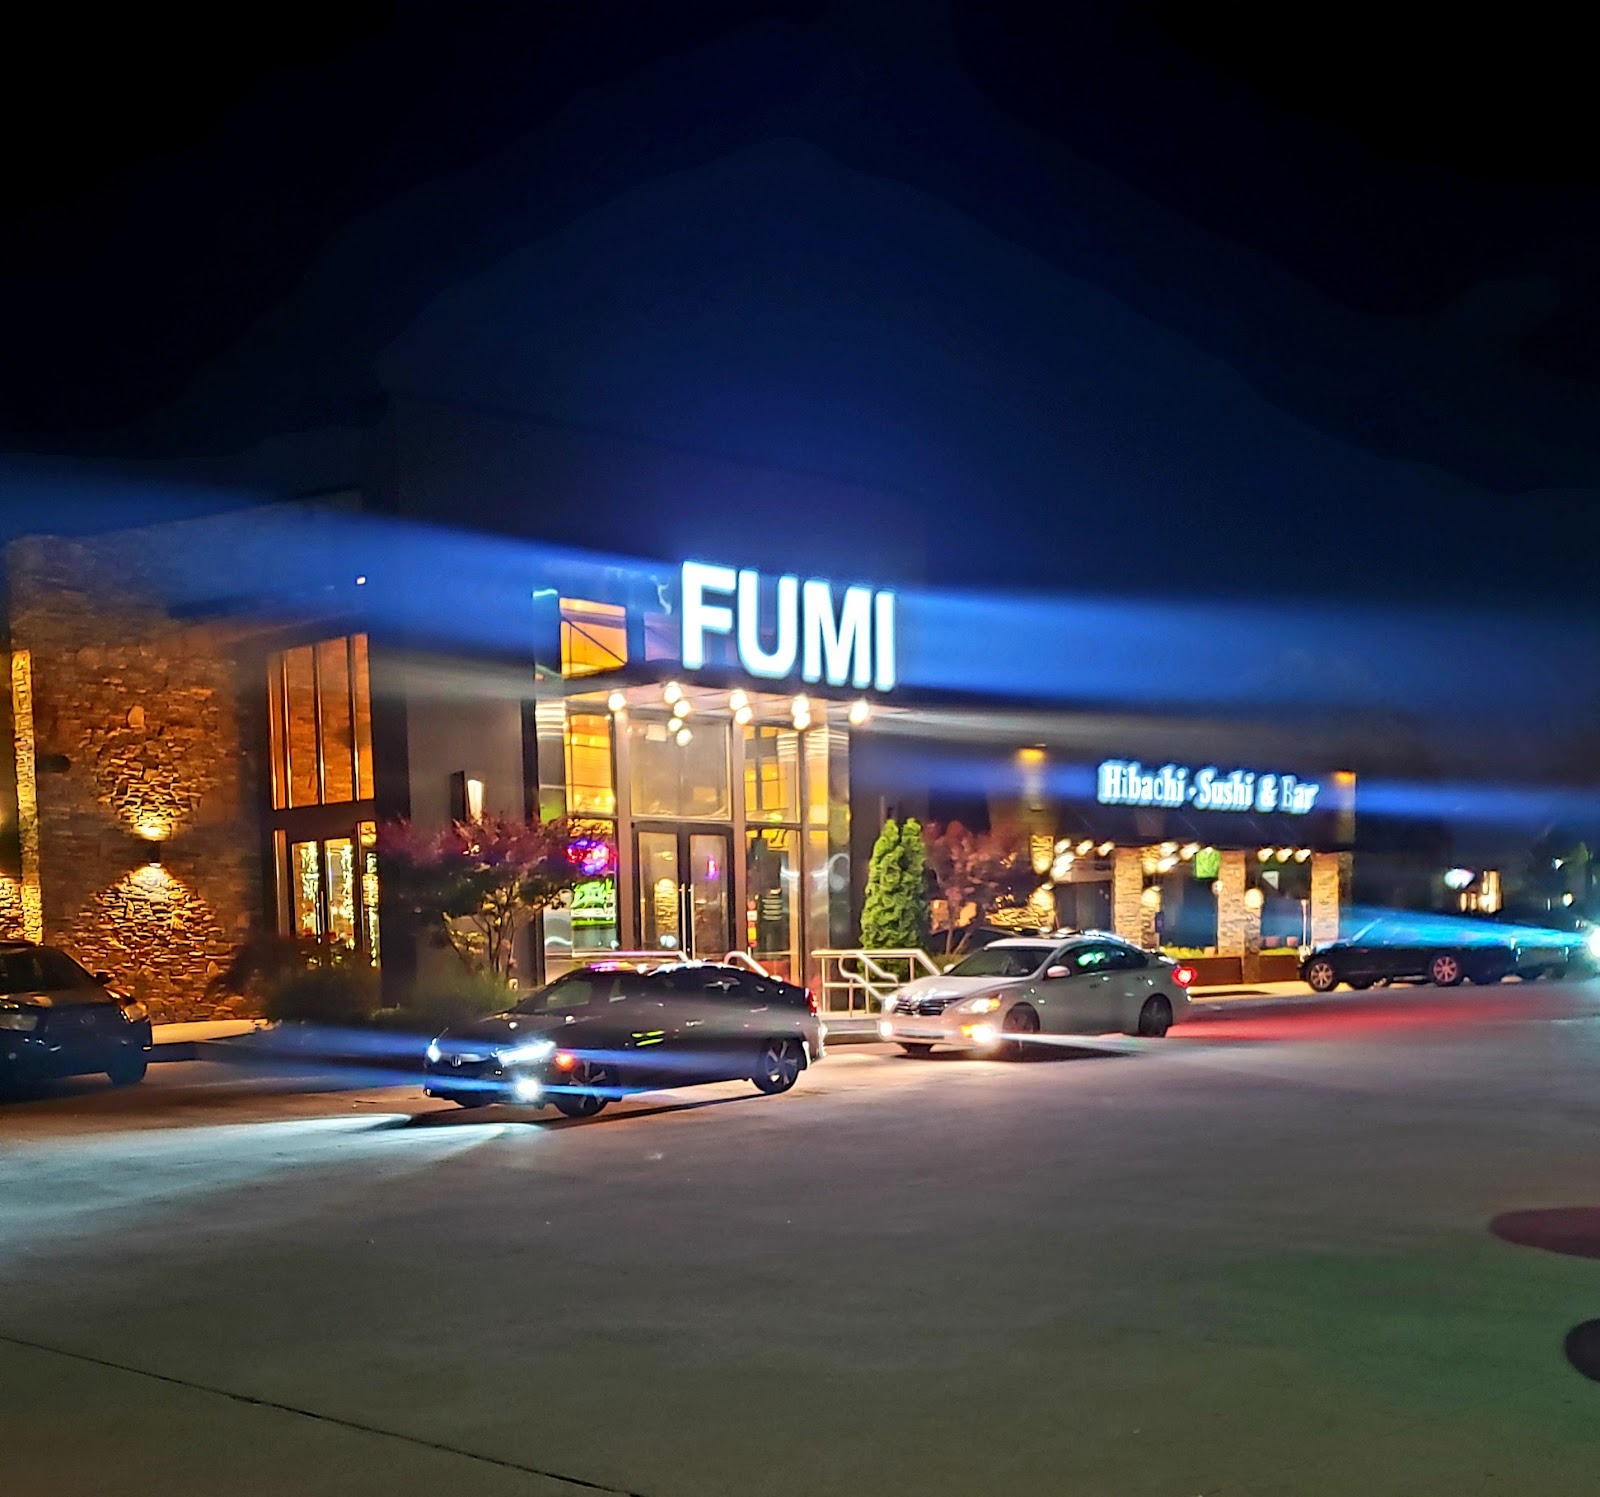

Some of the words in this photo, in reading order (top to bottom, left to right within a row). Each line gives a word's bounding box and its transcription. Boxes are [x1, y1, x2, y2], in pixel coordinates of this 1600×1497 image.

[681, 560, 896, 692] FUMI
[1098, 760, 1187, 807] Hibachi
[1195, 767, 1254, 811] Sushi
[1255, 774, 1278, 812] &
[1279, 775, 1319, 814] Bar
